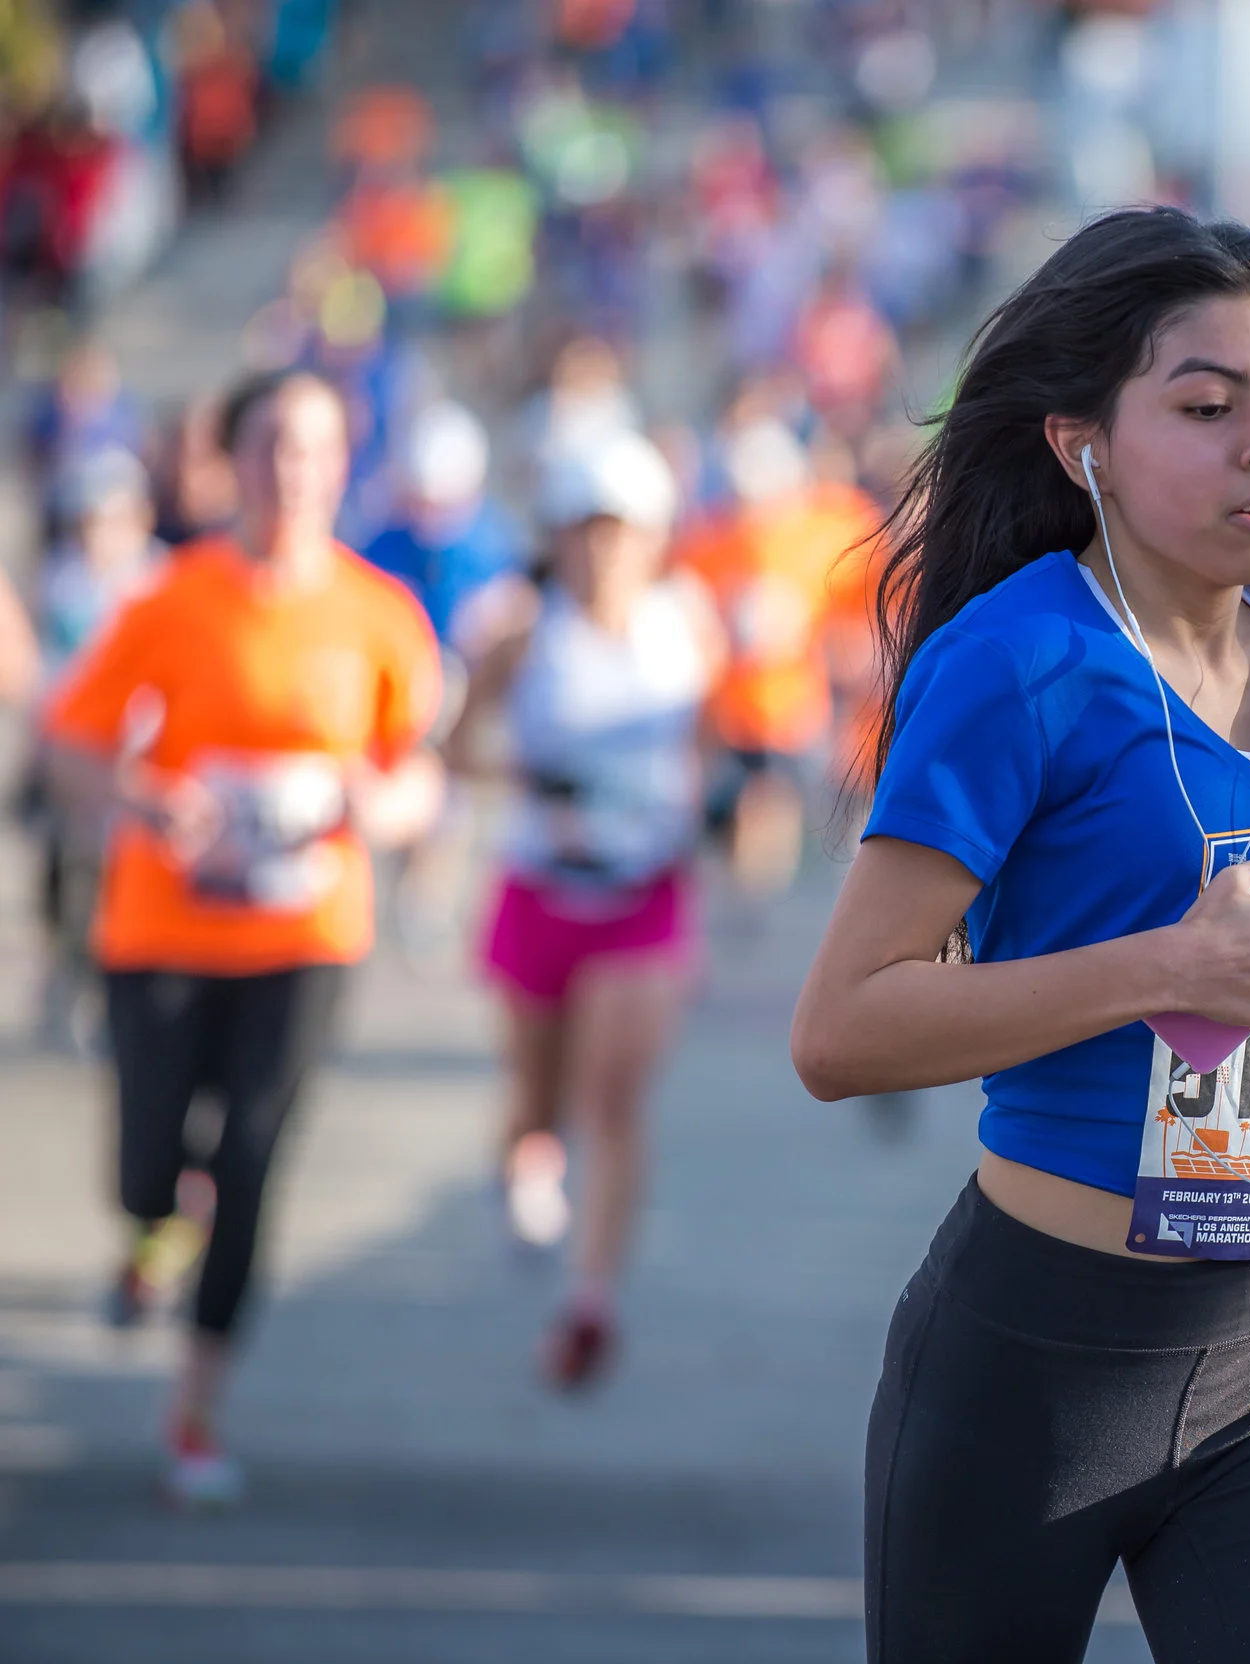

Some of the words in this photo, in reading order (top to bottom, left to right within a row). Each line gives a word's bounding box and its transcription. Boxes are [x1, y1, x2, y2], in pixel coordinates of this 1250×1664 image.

[1162, 1190, 1221, 1203] FEBRUARY
[1222, 1192, 1241, 1204] 13TH
[1197, 1222, 1217, 1231] LOS
